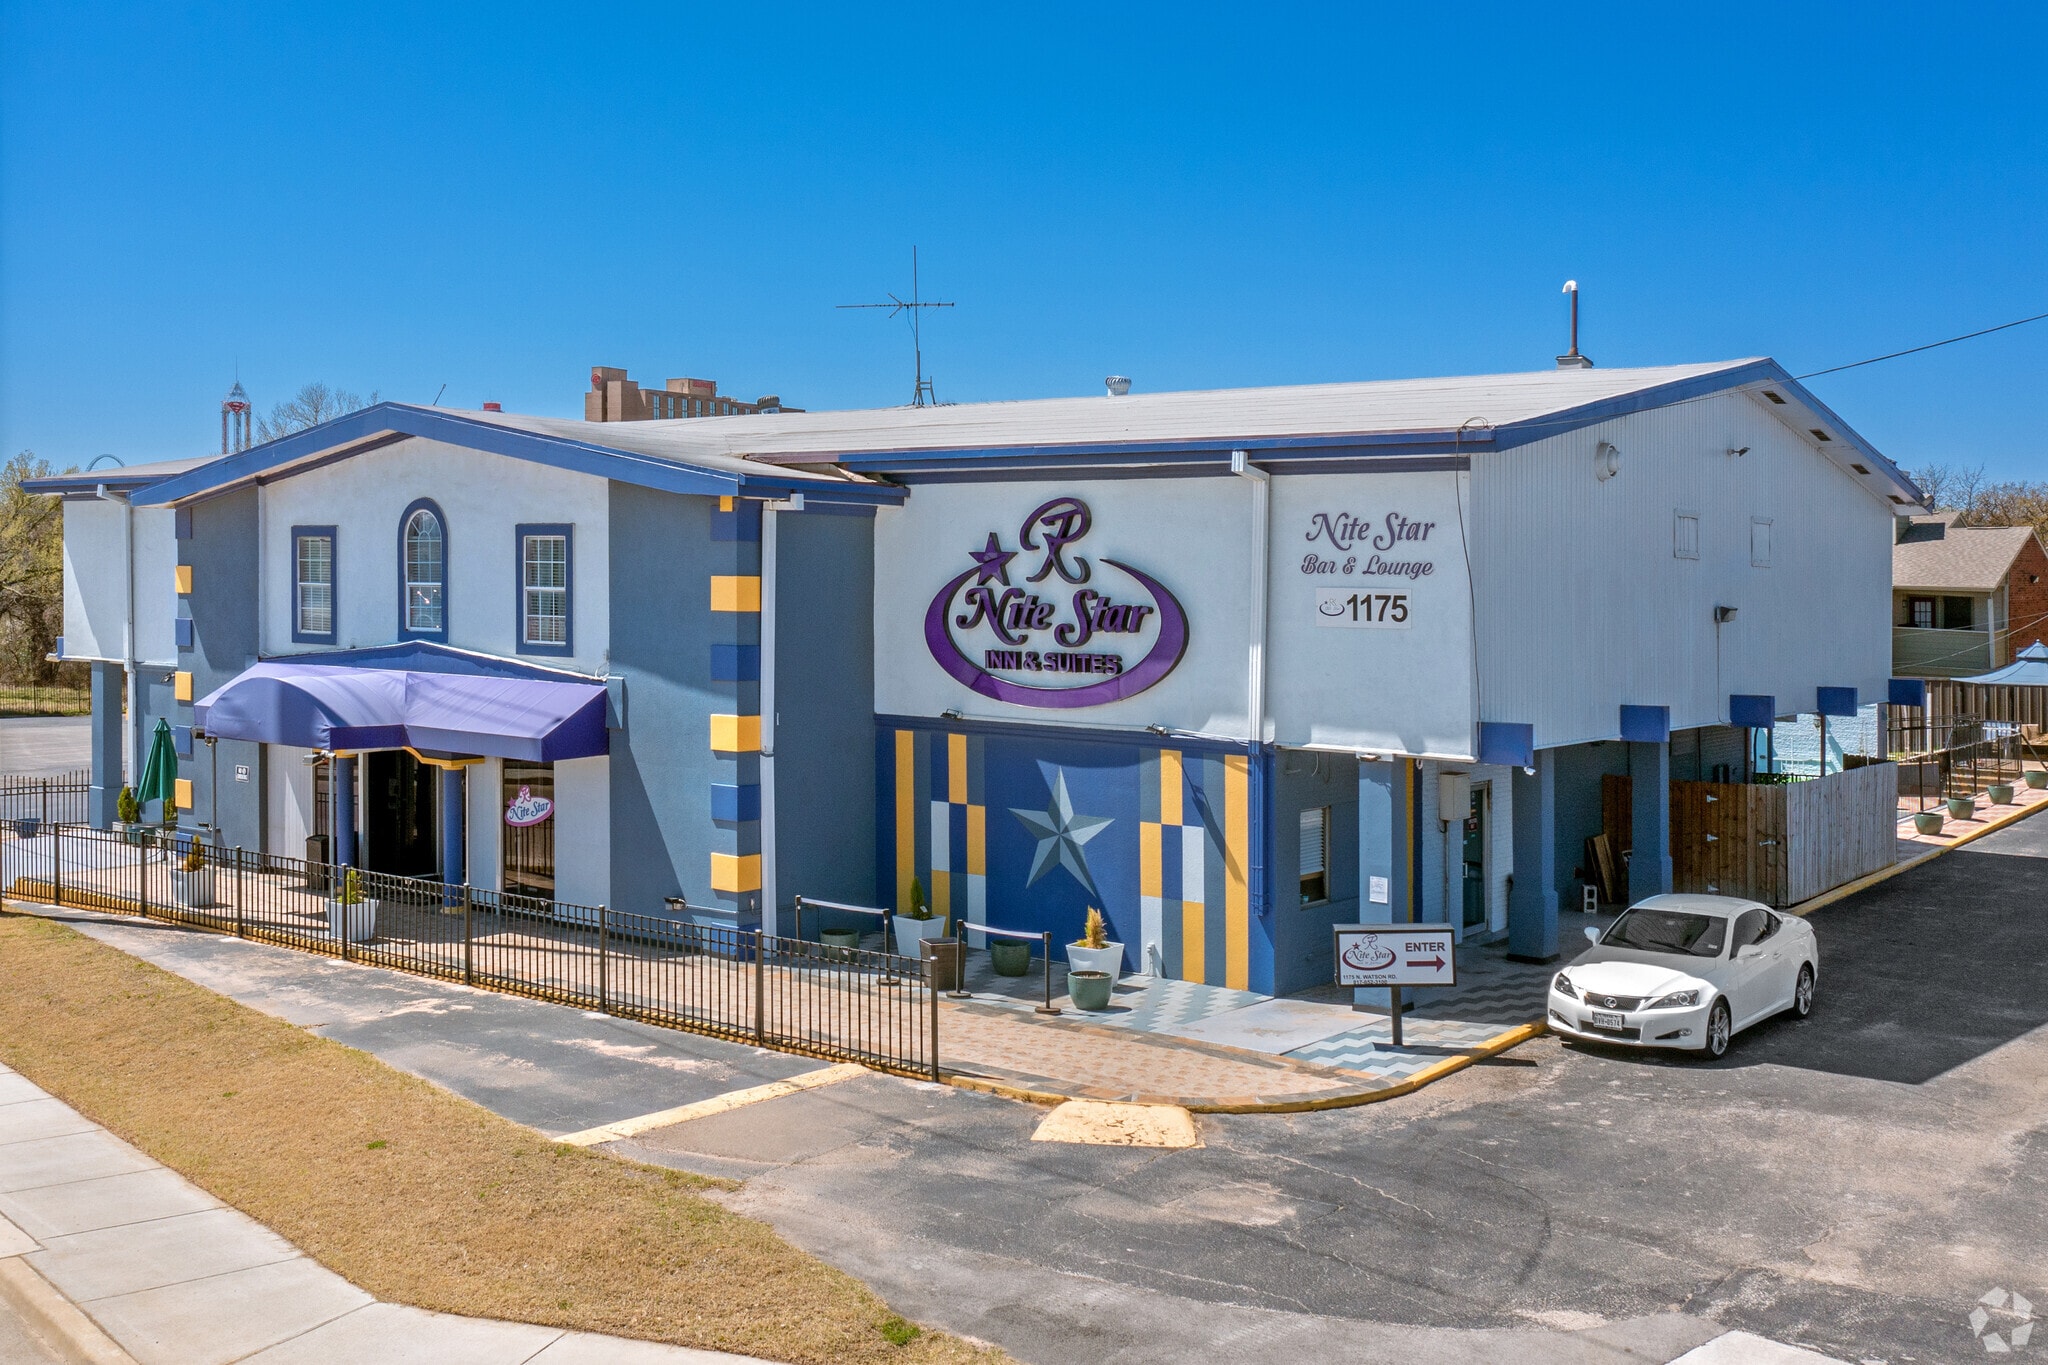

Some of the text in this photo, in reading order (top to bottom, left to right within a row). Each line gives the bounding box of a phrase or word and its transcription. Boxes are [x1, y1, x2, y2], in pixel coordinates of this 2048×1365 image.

[1305, 512, 1436, 551] Nite Star
[1301, 554, 1434, 580] Bar & Lounge
[956, 588, 1154, 648] Nite Star
[1346, 594, 1408, 623] 1175
[985, 650, 1123, 675] INN & SUITES
[509, 801, 549, 820] Nite Star
[1347, 950, 1391, 961] Nite Star
[1405, 942, 1445, 952] ENTER
